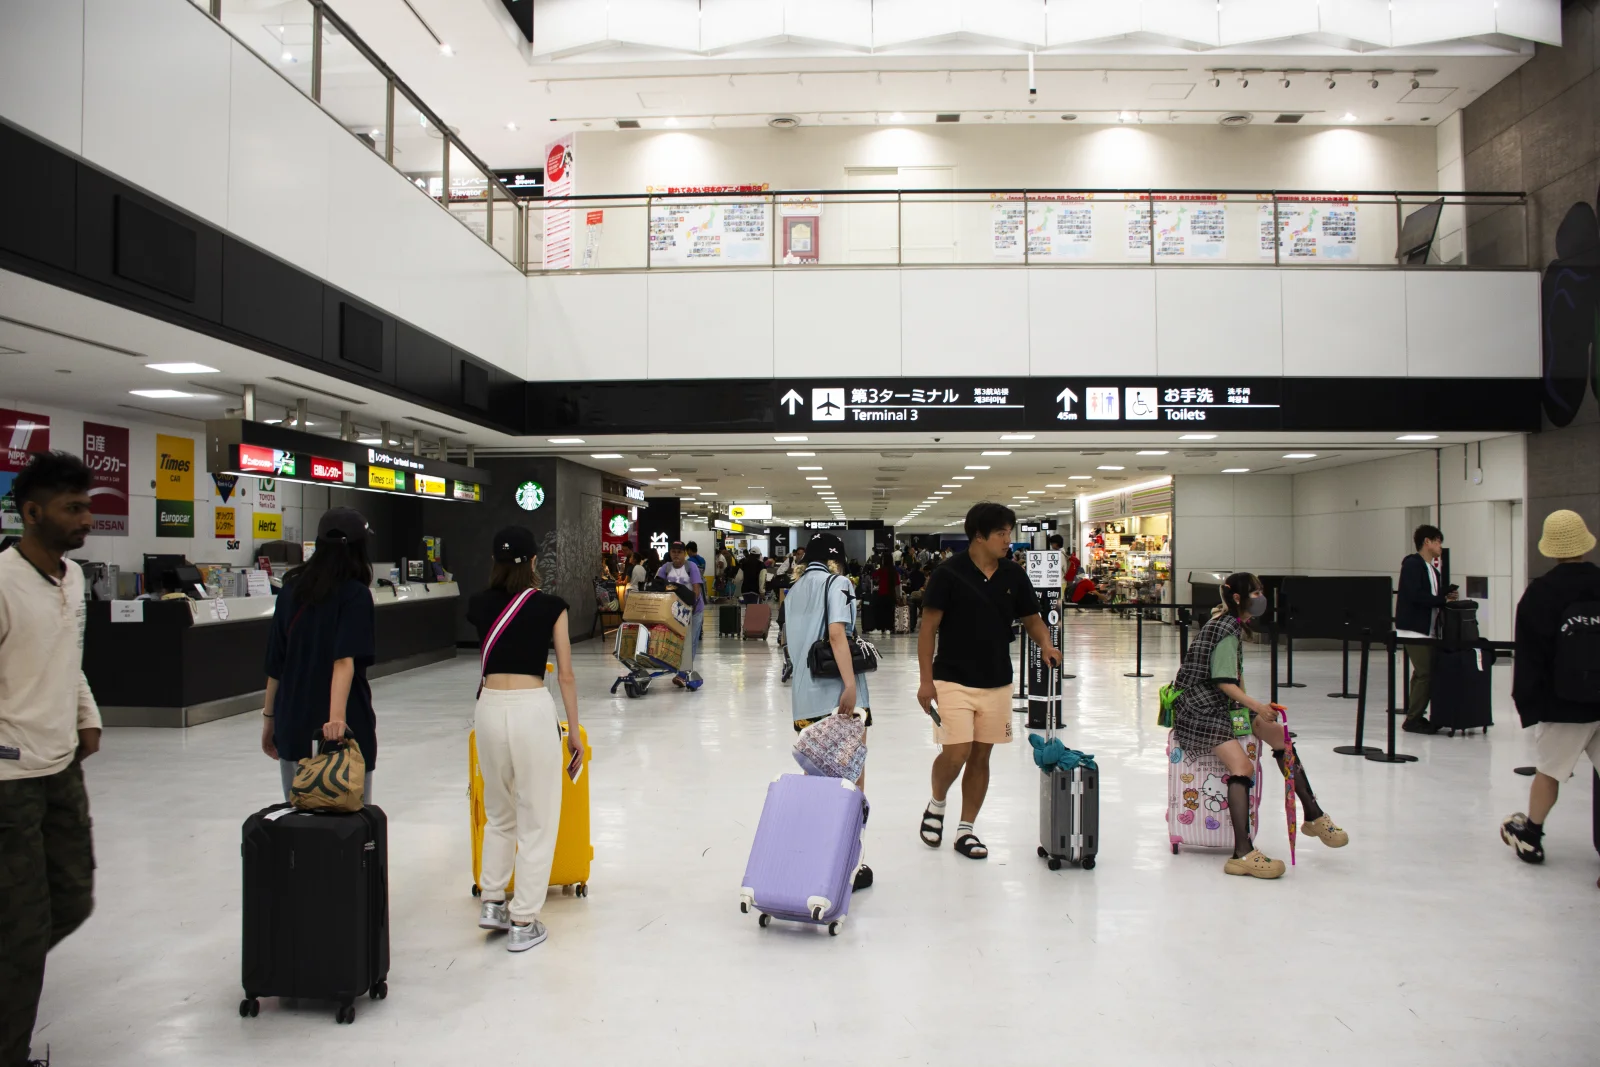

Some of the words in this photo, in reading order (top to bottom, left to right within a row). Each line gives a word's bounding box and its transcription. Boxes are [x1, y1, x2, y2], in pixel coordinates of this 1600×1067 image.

[451, 189, 482, 197] Elevator
[851, 388, 959, 404] 第3ターミナル
[1164, 388, 1214, 404] お手洗
[1227, 395, 1249, 404] 화장실
[852, 409, 908, 421] Terminal
[910, 409, 918, 421] 3
[1057, 412, 1078, 421] 45m
[1165, 408, 1206, 421] Toilets
[86, 434, 106, 453] 日産
[86, 454, 127, 473] レンタカー
[160, 453, 190, 472] Times
[170, 475, 181, 483] CAR
[371, 472, 385, 484] Times
[259, 493, 275, 501] TOYOTA
[161, 512, 190, 525] Europcar
[216, 521, 234, 531] レンタカー
[258, 520, 277, 532] Hertz
[1047, 590, 1059, 598] Entry
